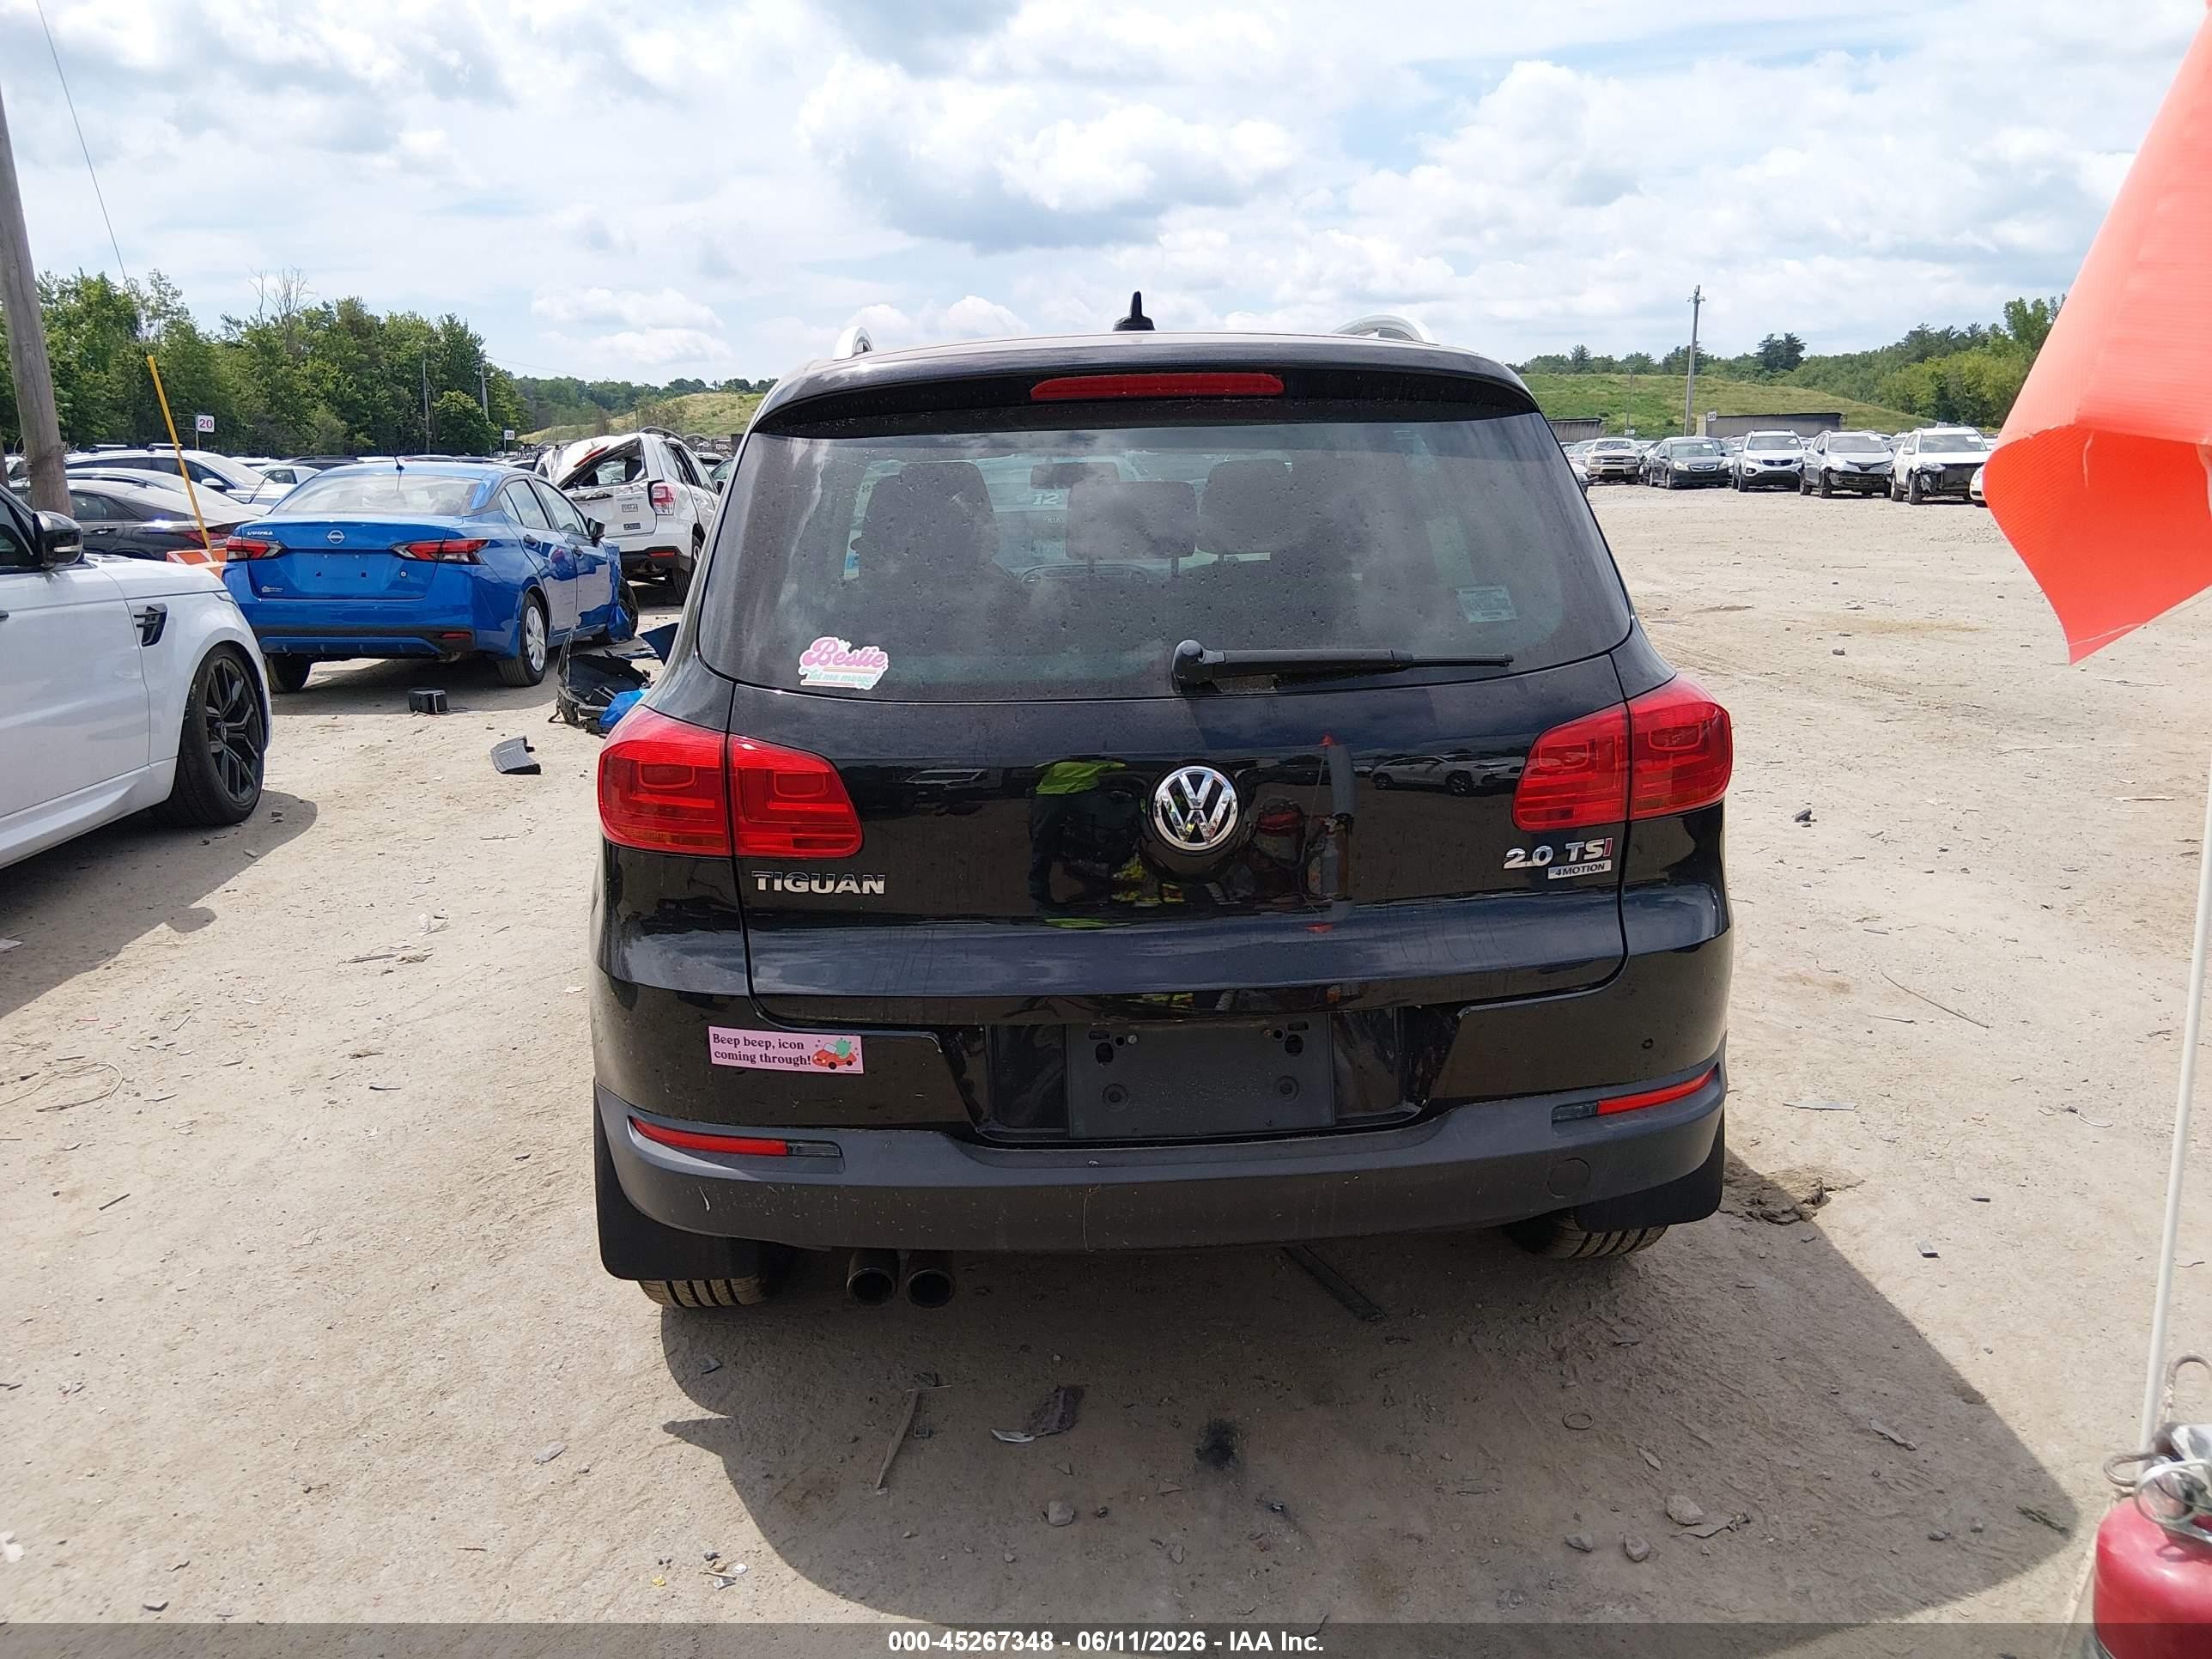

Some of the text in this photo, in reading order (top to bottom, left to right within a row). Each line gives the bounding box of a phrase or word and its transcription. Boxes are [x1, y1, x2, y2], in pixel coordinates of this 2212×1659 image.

[199, 418, 213, 428] 20
[802, 639, 886, 668] Bestie
[1565, 837, 1613, 862] TSI
[1554, 862, 1606, 877] 4MOTION
[751, 871, 886, 895] TIGUAN
[713, 1033, 805, 1050] Beep beep, icon
[714, 1050, 811, 1067] coming through!
